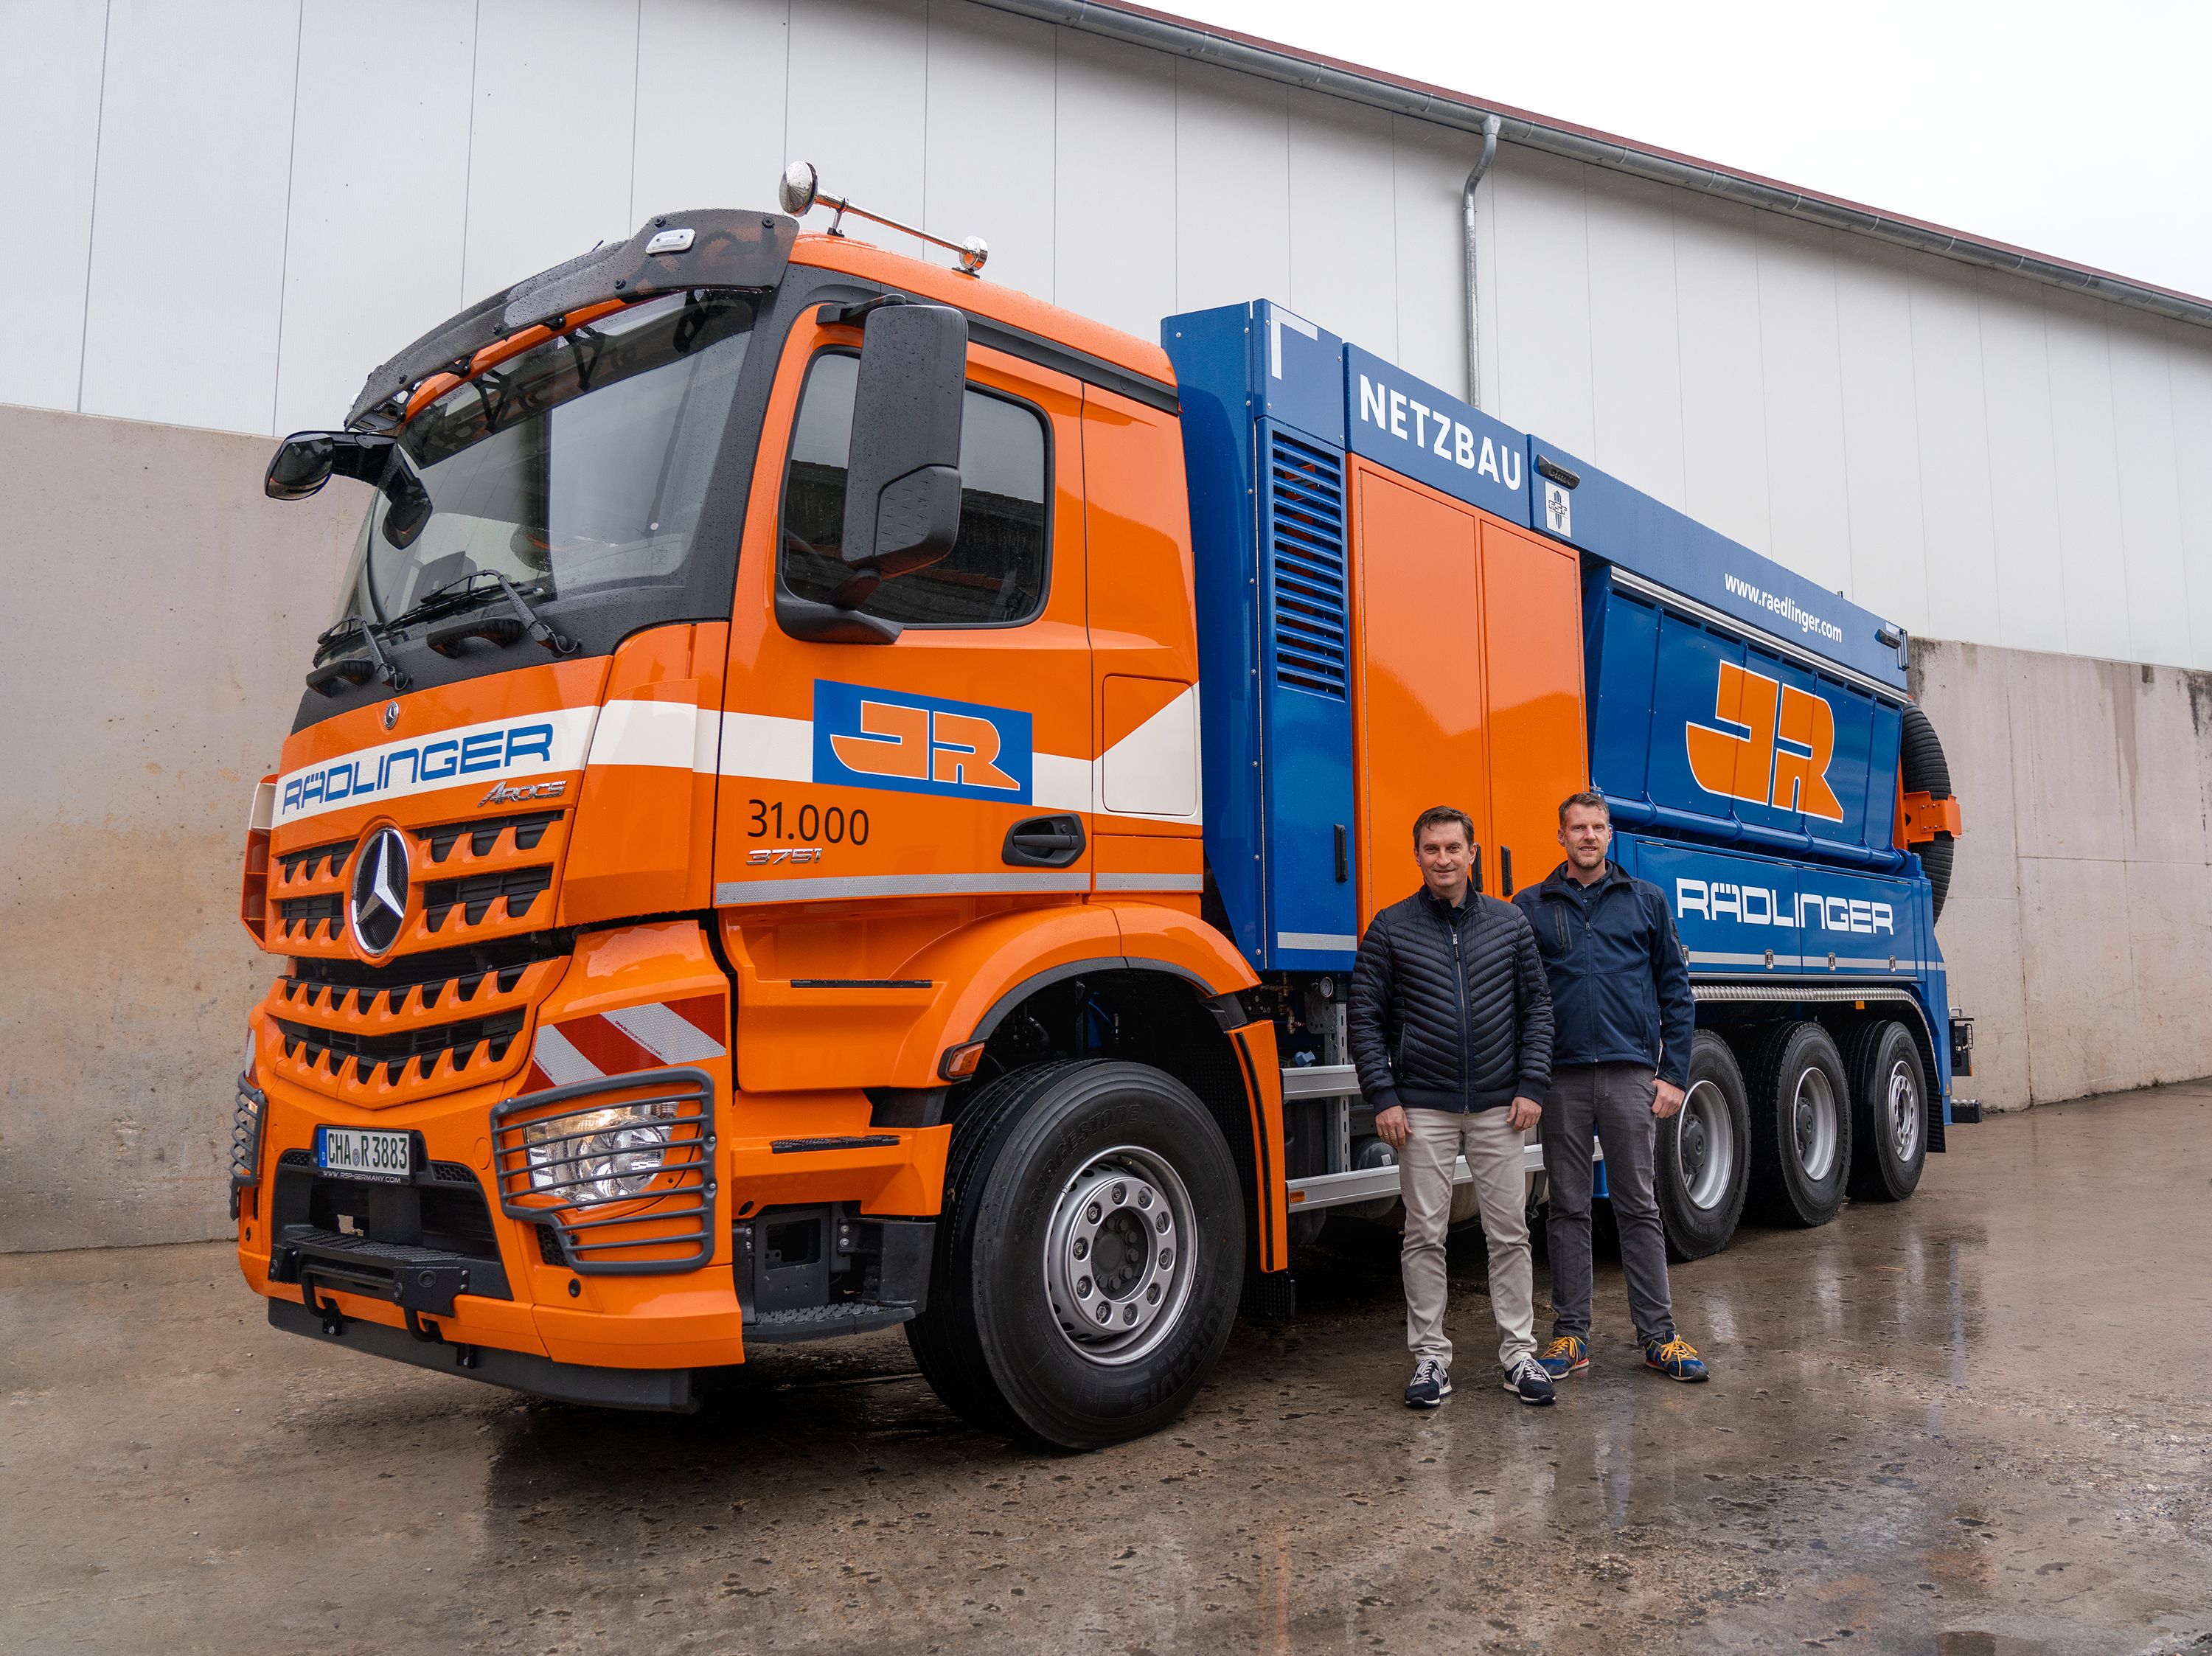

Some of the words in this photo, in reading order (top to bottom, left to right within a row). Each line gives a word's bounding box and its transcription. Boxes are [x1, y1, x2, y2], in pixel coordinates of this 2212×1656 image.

[1360, 373, 1521, 490] NETZBAU
[1725, 572, 1842, 643] www.raedlinger.com
[282, 723, 553, 815] RÄDLINGER
[748, 799, 869, 846] 31.000
[746, 848, 823, 865] 3751
[1676, 877, 1894, 936] RÄDLINGER
[328, 1133, 351, 1165] CHA
[361, 1135, 369, 1166] R
[372, 1136, 407, 1169] 3883
